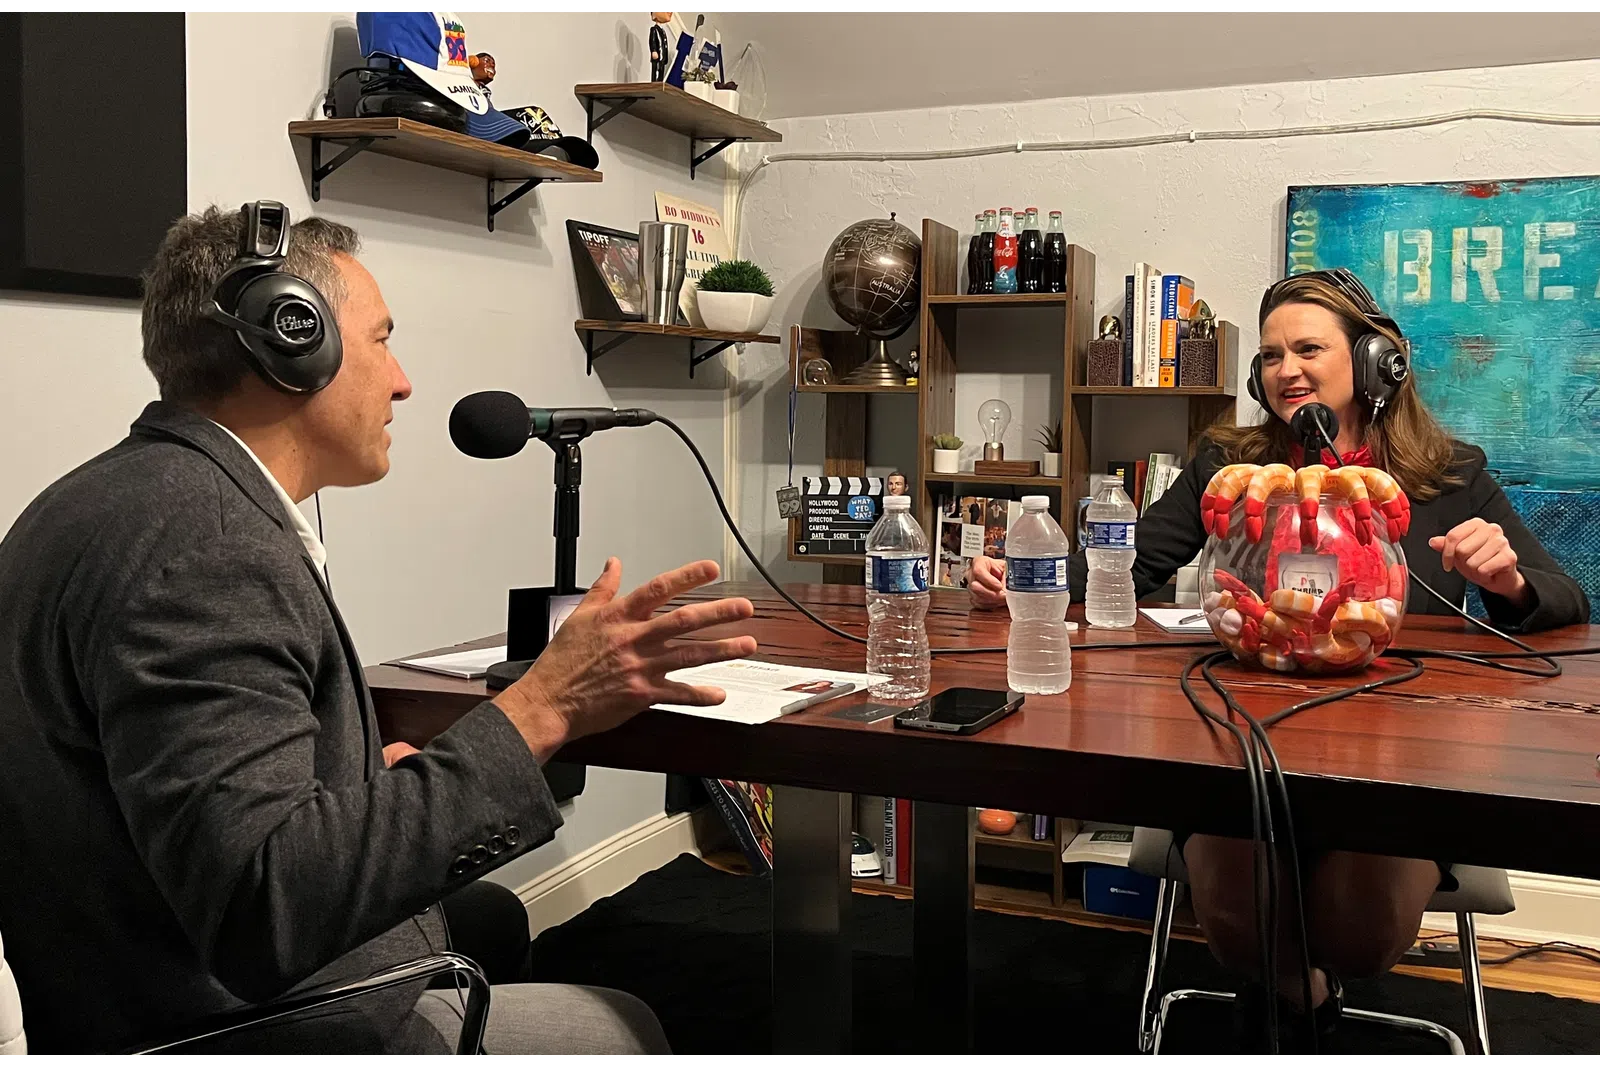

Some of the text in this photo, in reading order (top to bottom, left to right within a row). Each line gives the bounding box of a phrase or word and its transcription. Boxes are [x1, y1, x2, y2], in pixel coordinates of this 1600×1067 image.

[664, 205, 677, 217] BO
[578, 229, 610, 245] TIPOFF
[691, 228, 705, 245] 16
[1383, 221, 1600, 303] BRE
[871, 279, 901, 295] AUSTRALIA
[1168, 280, 1176, 319] PREDICTABLY
[277, 315, 315, 331] Blue
[854, 511, 872, 519] SAYS
[716, 794, 724, 804] TO
[884, 826, 893, 858] INVESTOR
